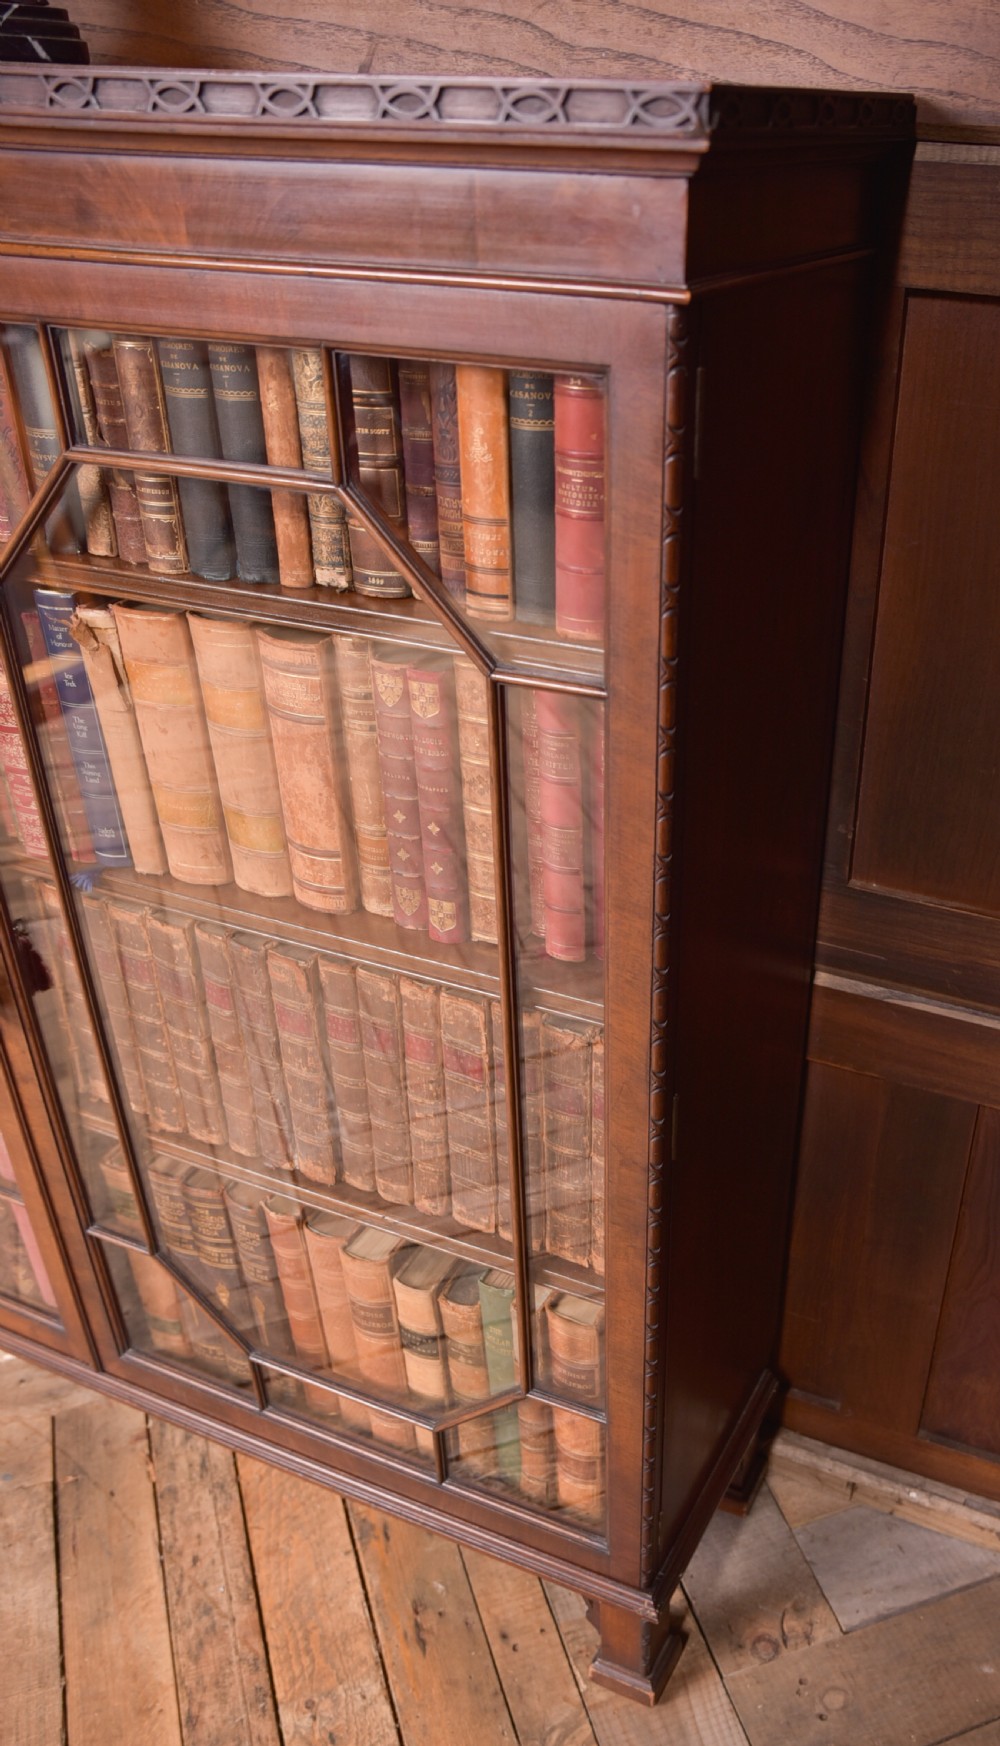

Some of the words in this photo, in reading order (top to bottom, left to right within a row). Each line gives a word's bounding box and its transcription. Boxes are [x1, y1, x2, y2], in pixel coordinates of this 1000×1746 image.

[510, 390, 553, 401] CASANOV
[63, 671, 74, 680] Ice
[63, 679, 77, 689] Trek
[72, 715, 86, 724] The
[73, 722, 88, 732] Long
[76, 730, 88, 739] Kill
